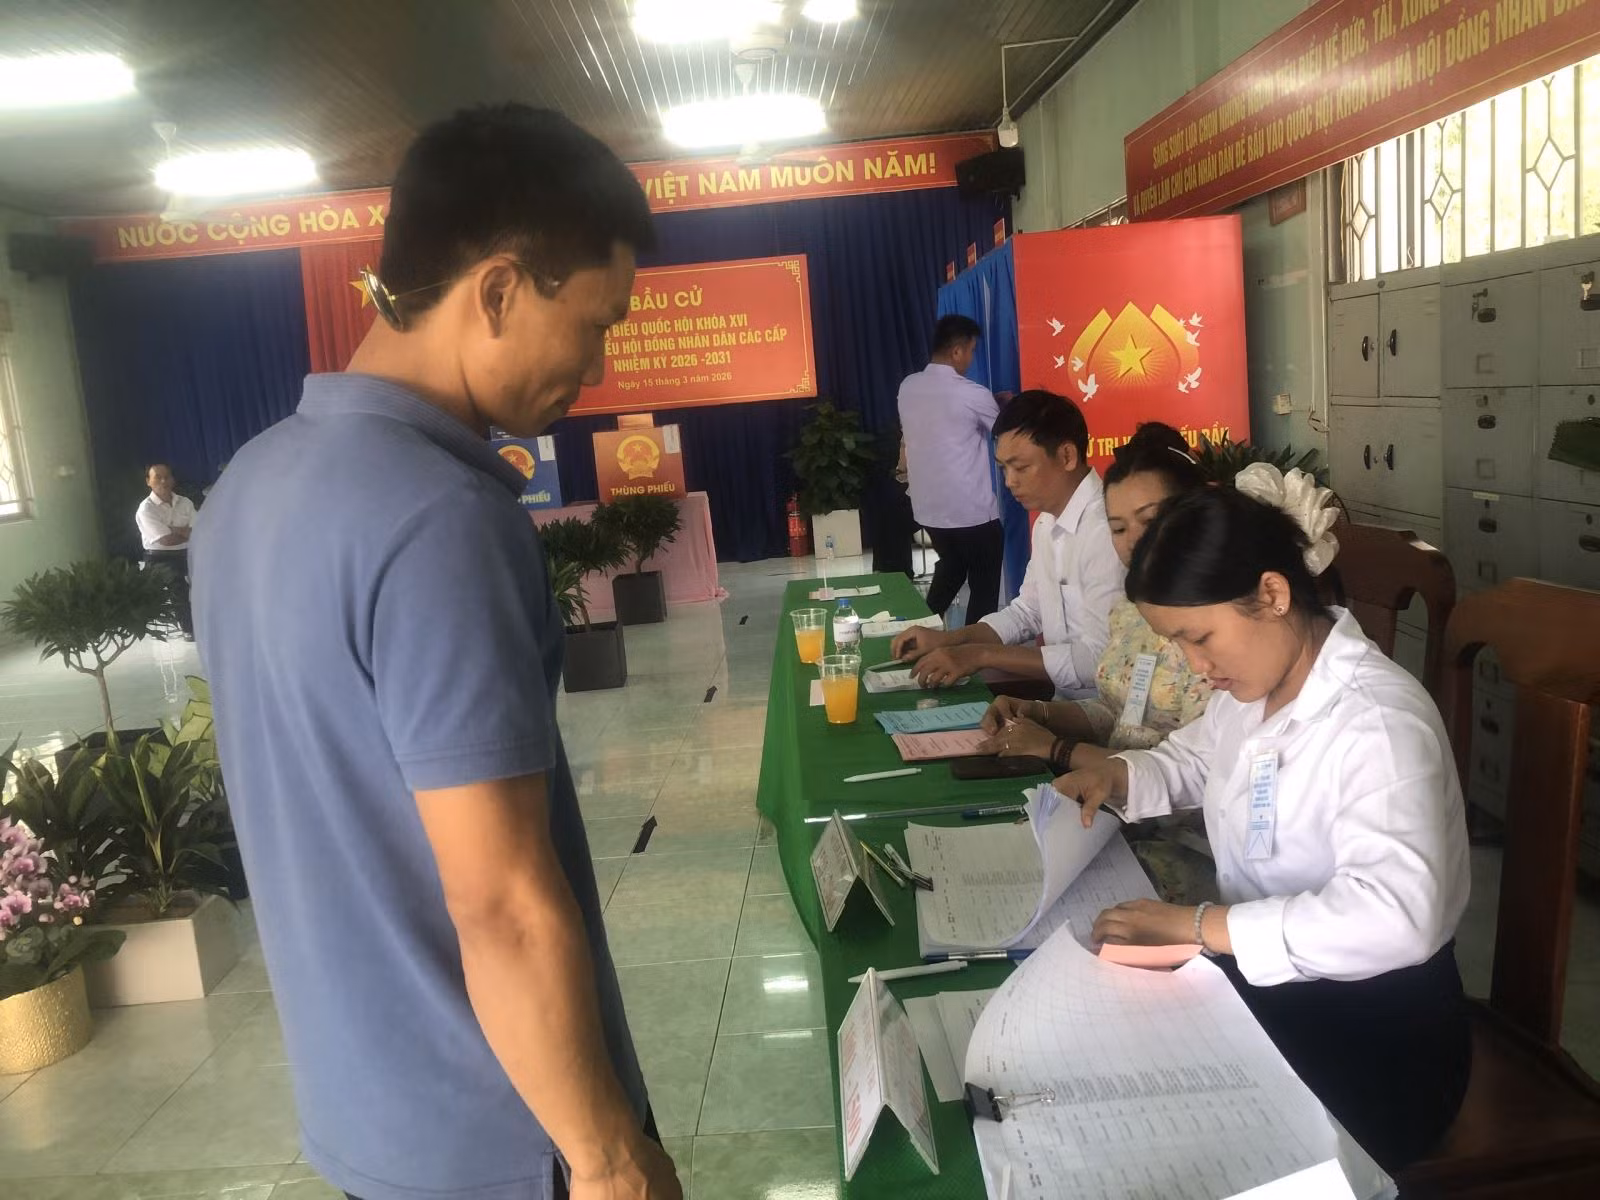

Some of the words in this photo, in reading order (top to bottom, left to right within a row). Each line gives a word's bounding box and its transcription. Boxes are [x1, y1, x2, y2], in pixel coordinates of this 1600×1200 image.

[1371, 61, 1391, 105] XVI
[1417, 30, 1441, 86] HỘI
[1445, 7, 1490, 68] ĐỒNG
[699, 168, 761, 195] NAM
[770, 156, 854, 188] MUÔN
[864, 150, 936, 180] NĂM!
[207, 212, 290, 245] CỘNG
[299, 204, 360, 233] HÒA
[368, 205, 385, 226] X
[630, 287, 668, 311] BẦU
[674, 285, 703, 307] CỬ
[612, 318, 639, 337] BIỂU
[641, 316, 671, 336] QUỐC
[674, 315, 693, 335] HỘI
[696, 313, 727, 331] KHÓA
[729, 313, 748, 328] XVI
[604, 336, 620, 356] ỂU
[622, 338, 641, 355] HỘI
[644, 335, 675, 353] ĐỒNG
[678, 332, 710, 349] NHÂN
[712, 330, 737, 347] DÂN
[739, 328, 762, 345] CÁC
[764, 323, 788, 342] CẤP
[613, 354, 650, 374] NHIỆM
[670, 353, 698, 368] 2026
[618, 379, 641, 390] Ngày
[643, 378, 653, 388] 15
[655, 376, 681, 387] tháng
[683, 375, 688, 384] 3
[690, 373, 709, 384] năm
[711, 371, 732, 382] 2026
[521, 490, 551, 504] PHIẾU
[610, 484, 646, 497] THÙNG
[647, 481, 676, 493] PHIẾU
